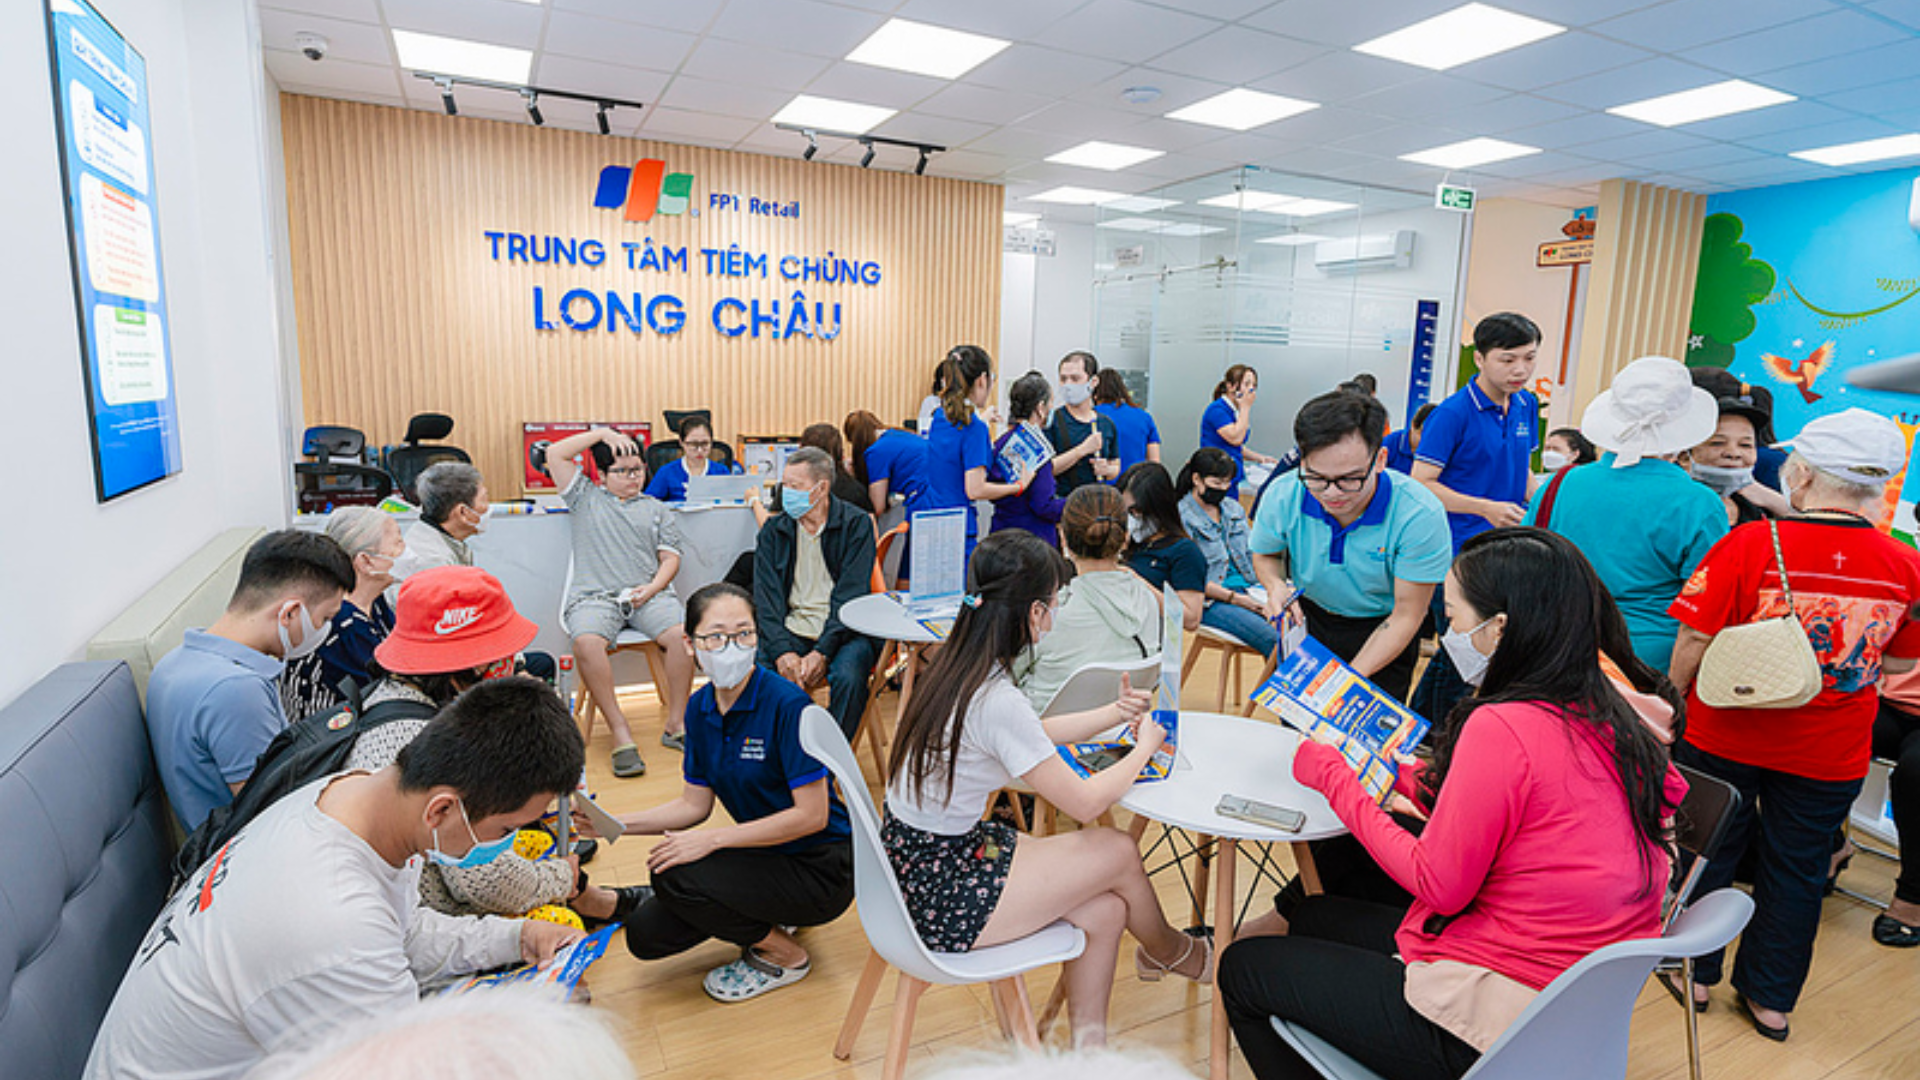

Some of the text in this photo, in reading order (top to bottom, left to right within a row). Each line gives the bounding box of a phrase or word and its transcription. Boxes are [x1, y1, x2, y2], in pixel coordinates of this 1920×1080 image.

[709, 193, 799, 218] FPT Retail
[484, 231, 882, 286] TRUNG TÂM TIÊM CHỦNG
[533, 286, 842, 340] LONG CHÂU
[440, 605, 479, 625] NIKE
